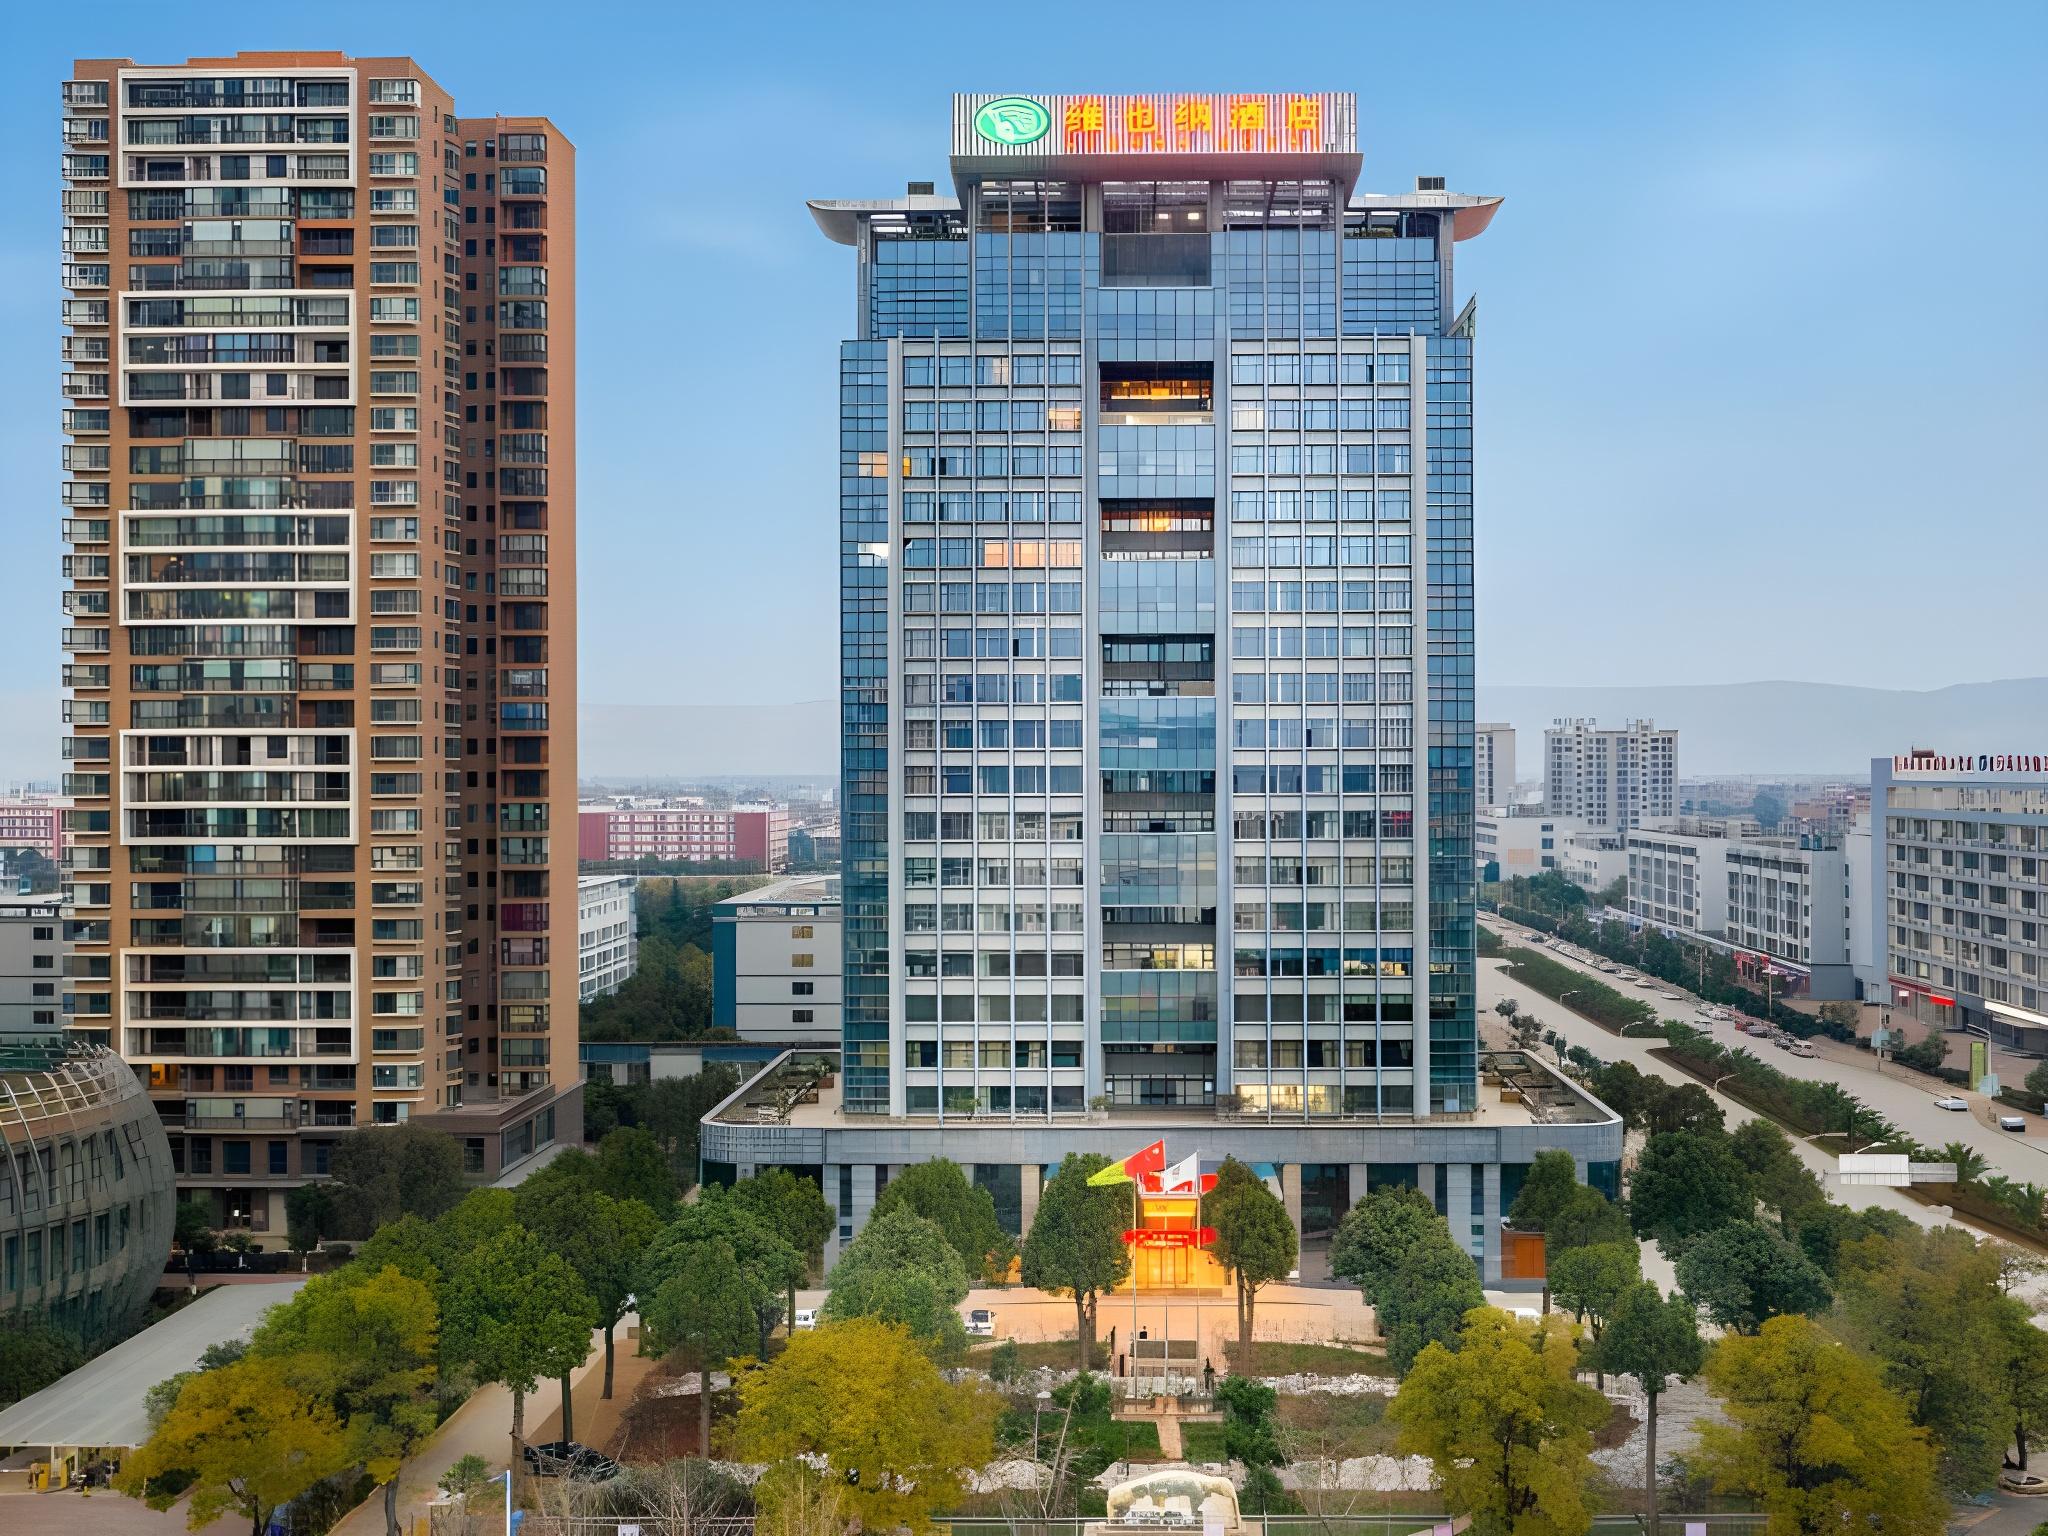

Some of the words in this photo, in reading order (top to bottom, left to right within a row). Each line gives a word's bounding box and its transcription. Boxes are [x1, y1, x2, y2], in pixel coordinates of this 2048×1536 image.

[1065, 97, 1319, 132] 维也纳酒店
